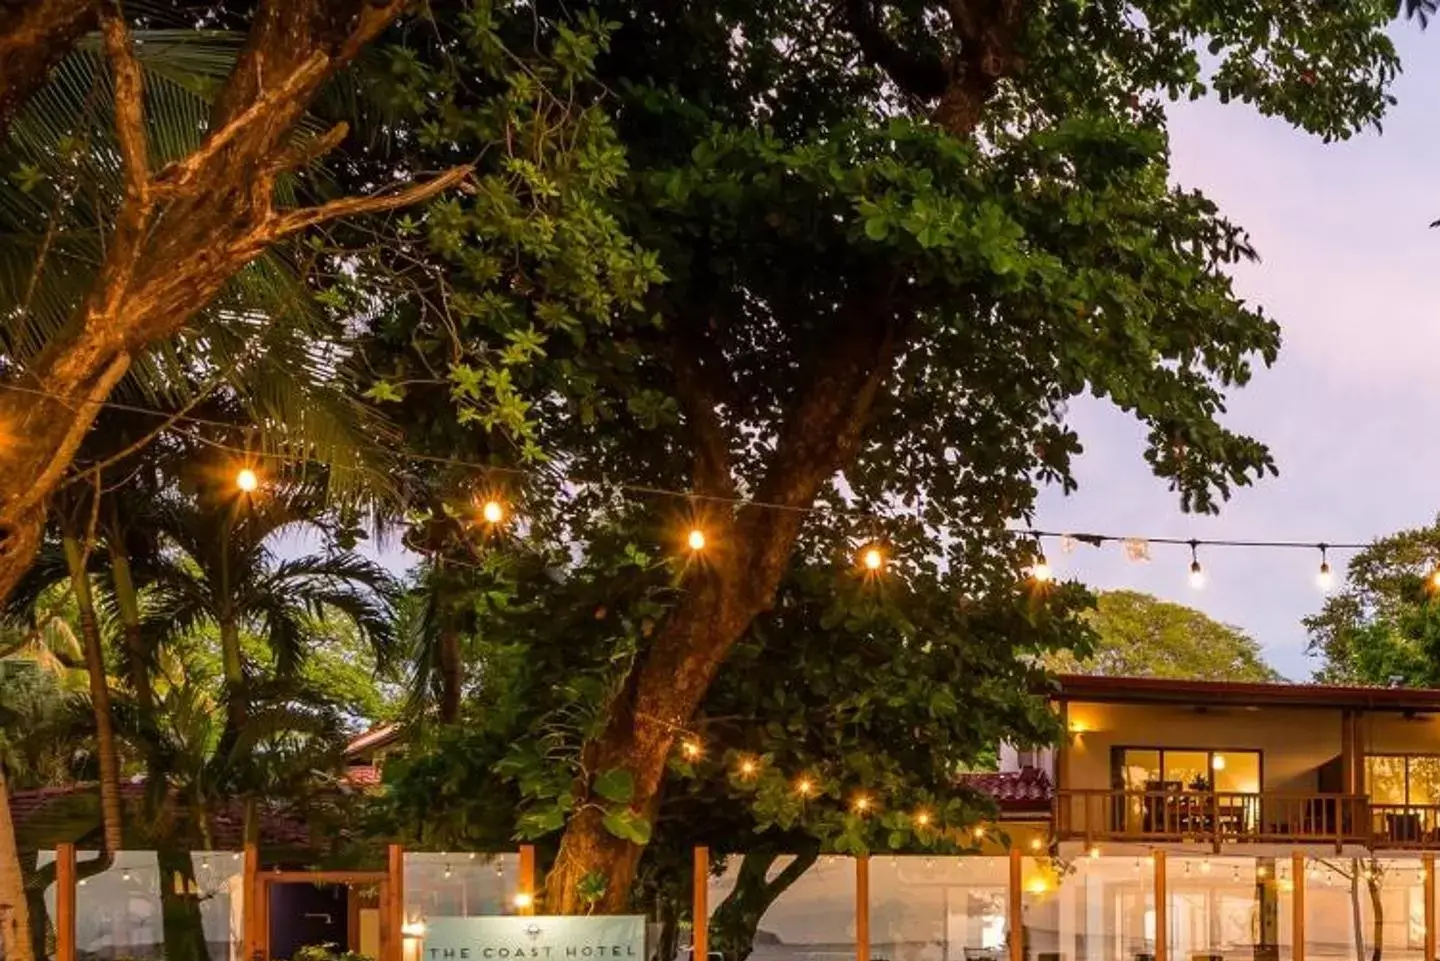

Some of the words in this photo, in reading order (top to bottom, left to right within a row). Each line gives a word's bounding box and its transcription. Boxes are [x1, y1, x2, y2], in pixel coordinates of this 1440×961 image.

[430, 947, 470, 960] THE
[483, 946, 552, 959] COAST
[566, 945, 636, 957] HOTEL
